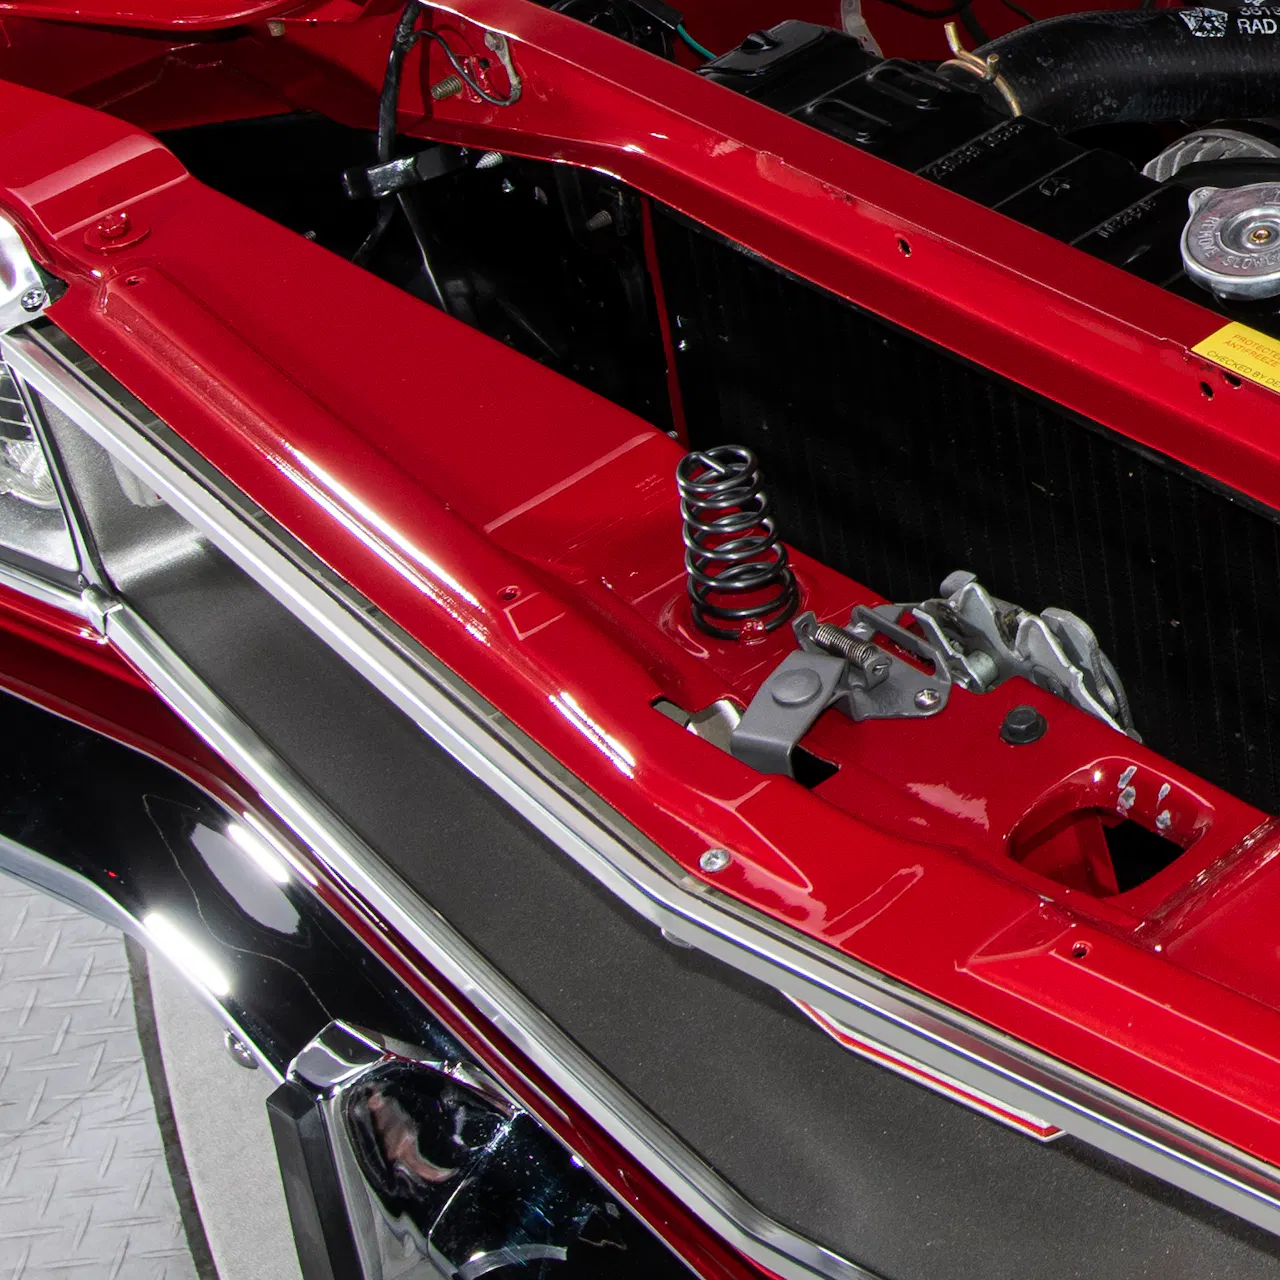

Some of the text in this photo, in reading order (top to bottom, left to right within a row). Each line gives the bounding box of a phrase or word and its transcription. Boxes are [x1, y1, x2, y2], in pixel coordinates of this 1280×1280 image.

[1237, 17, 1277, 34] RAD
[1197, 216, 1220, 259] REMOVE
[1205, 350, 1253, 373] CHECKED
[1250, 371, 1267, 380] BY
[1223, 339, 1280, 366] ANTIFREEZE
